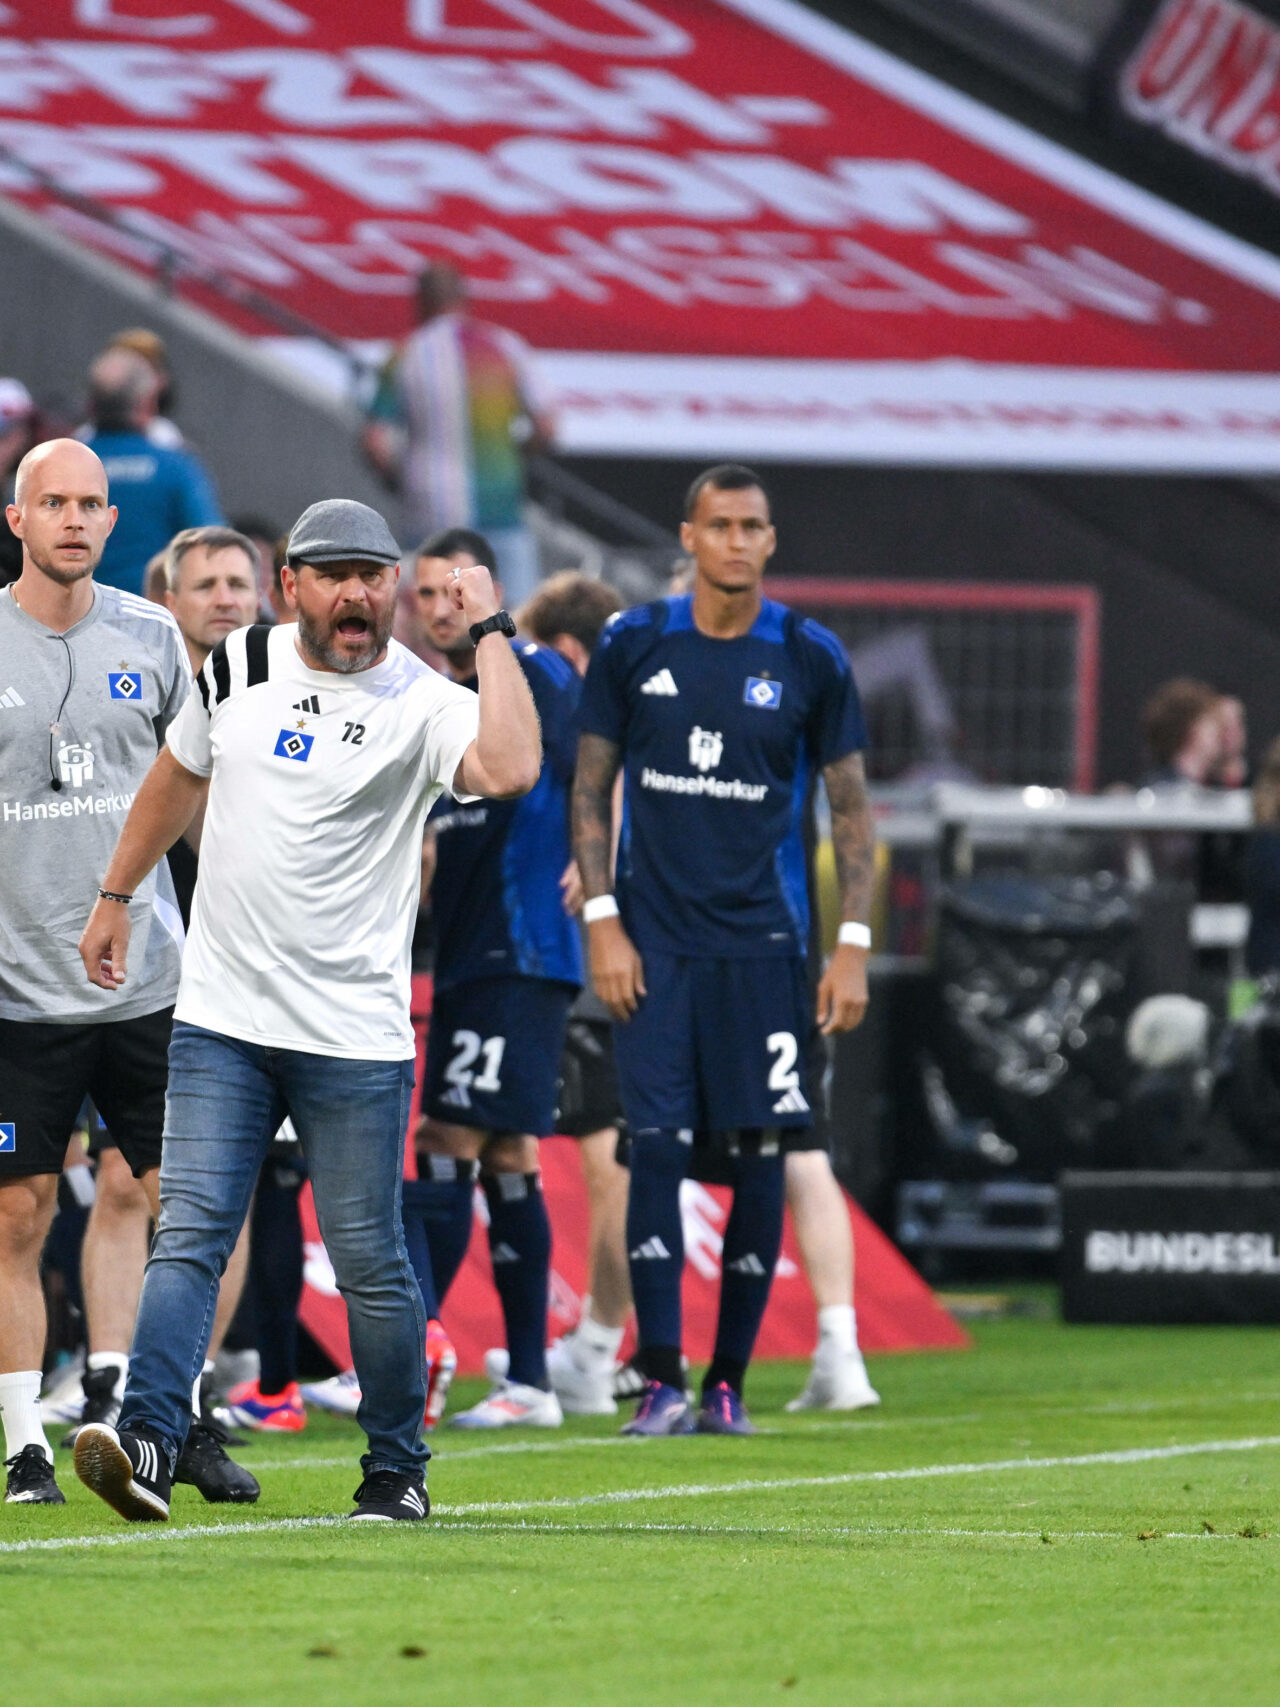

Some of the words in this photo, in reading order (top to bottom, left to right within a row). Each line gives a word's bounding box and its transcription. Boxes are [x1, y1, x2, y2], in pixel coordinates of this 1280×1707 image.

[341, 721, 366, 745] 72
[641, 767, 768, 802] HanseMerkur
[444, 1029, 506, 1092] 21
[766, 1031, 800, 1091] 2
